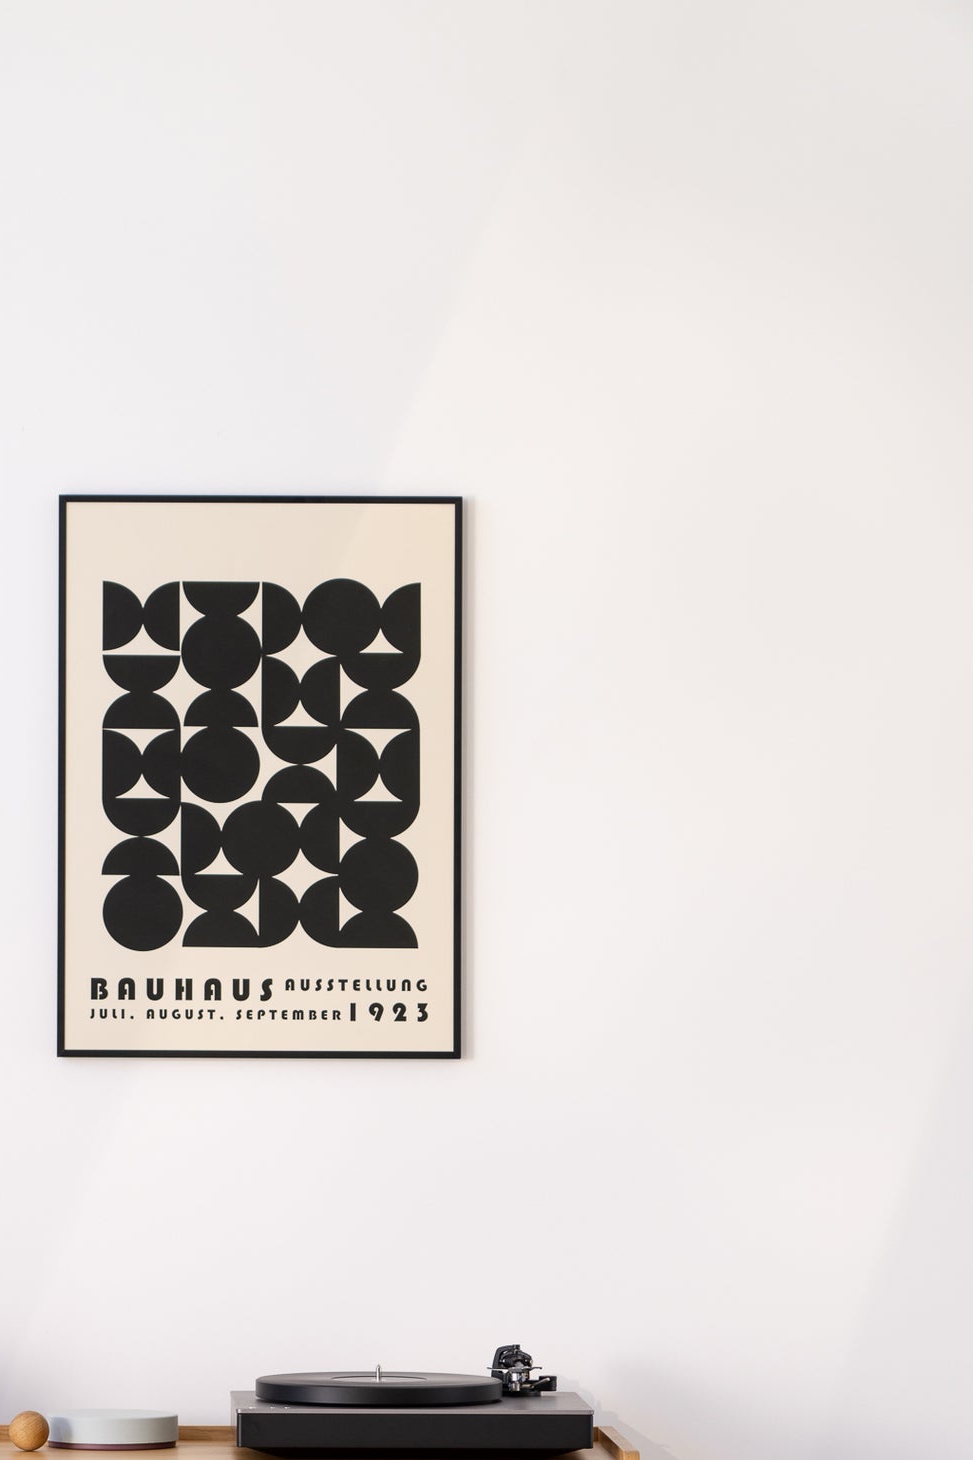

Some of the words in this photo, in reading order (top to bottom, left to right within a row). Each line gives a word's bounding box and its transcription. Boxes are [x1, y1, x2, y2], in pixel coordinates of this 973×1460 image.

[90, 977, 274, 1002] BAUHAUS
[285, 978, 429, 993] AUSSTELLUNG
[90, 1008, 135, 1021] JULI.
[146, 1008, 225, 1021] AUGUST.
[235, 1009, 342, 1021] SEPTEMBER
[349, 1002, 429, 1022] 1923
